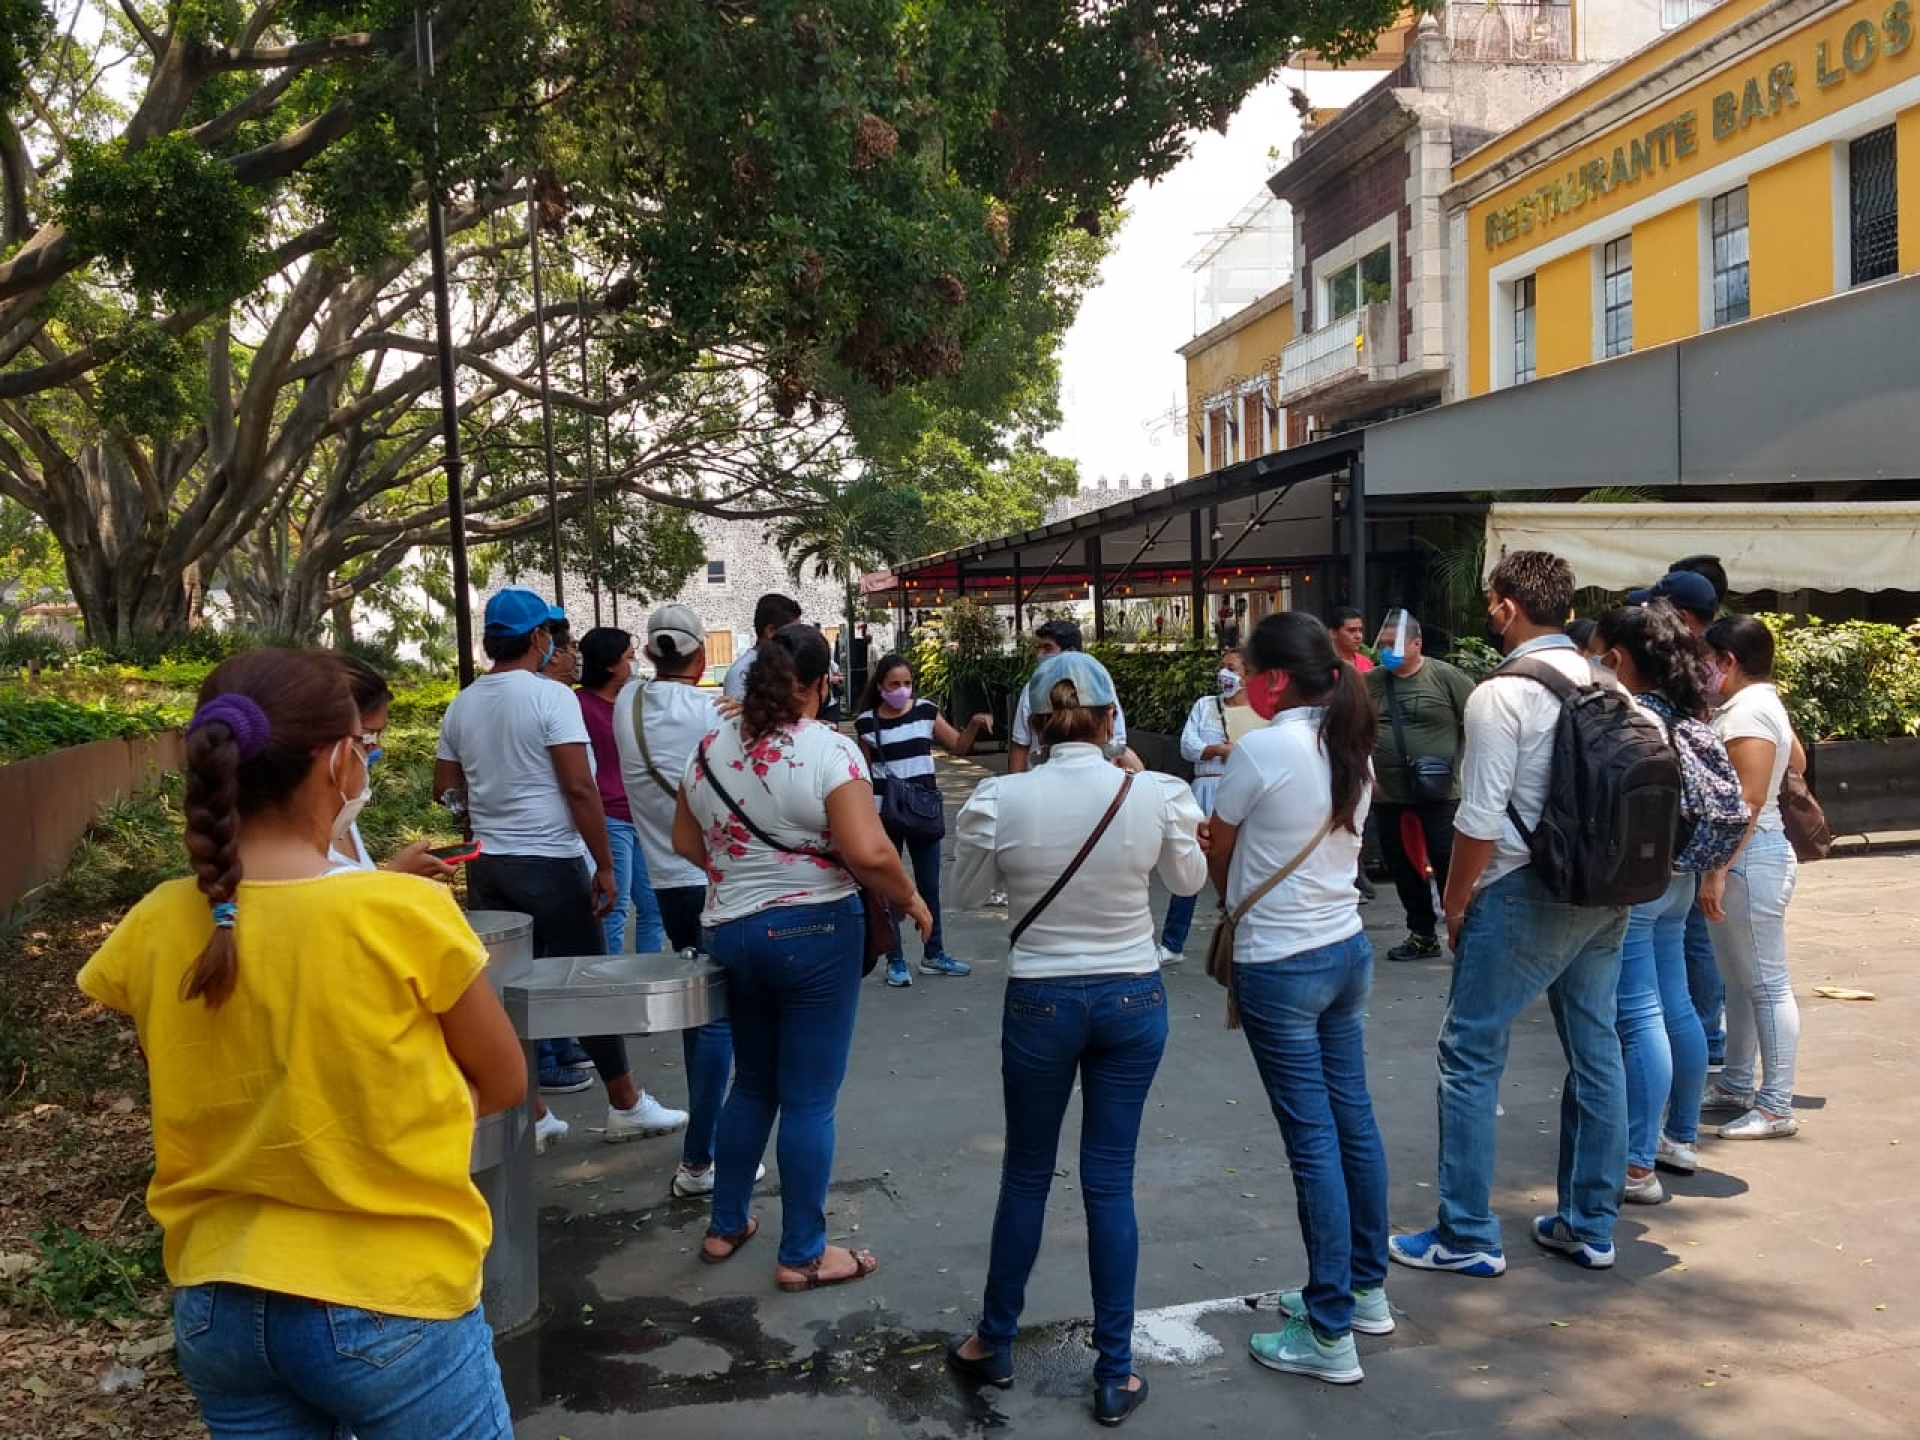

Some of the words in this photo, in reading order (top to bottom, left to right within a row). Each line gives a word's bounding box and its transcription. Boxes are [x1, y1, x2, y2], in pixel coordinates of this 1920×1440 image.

[1485, 109, 1696, 251] RESTAURANTE
[1713, 61, 1797, 139] BAR
[1816, 0, 1910, 89] LOS
